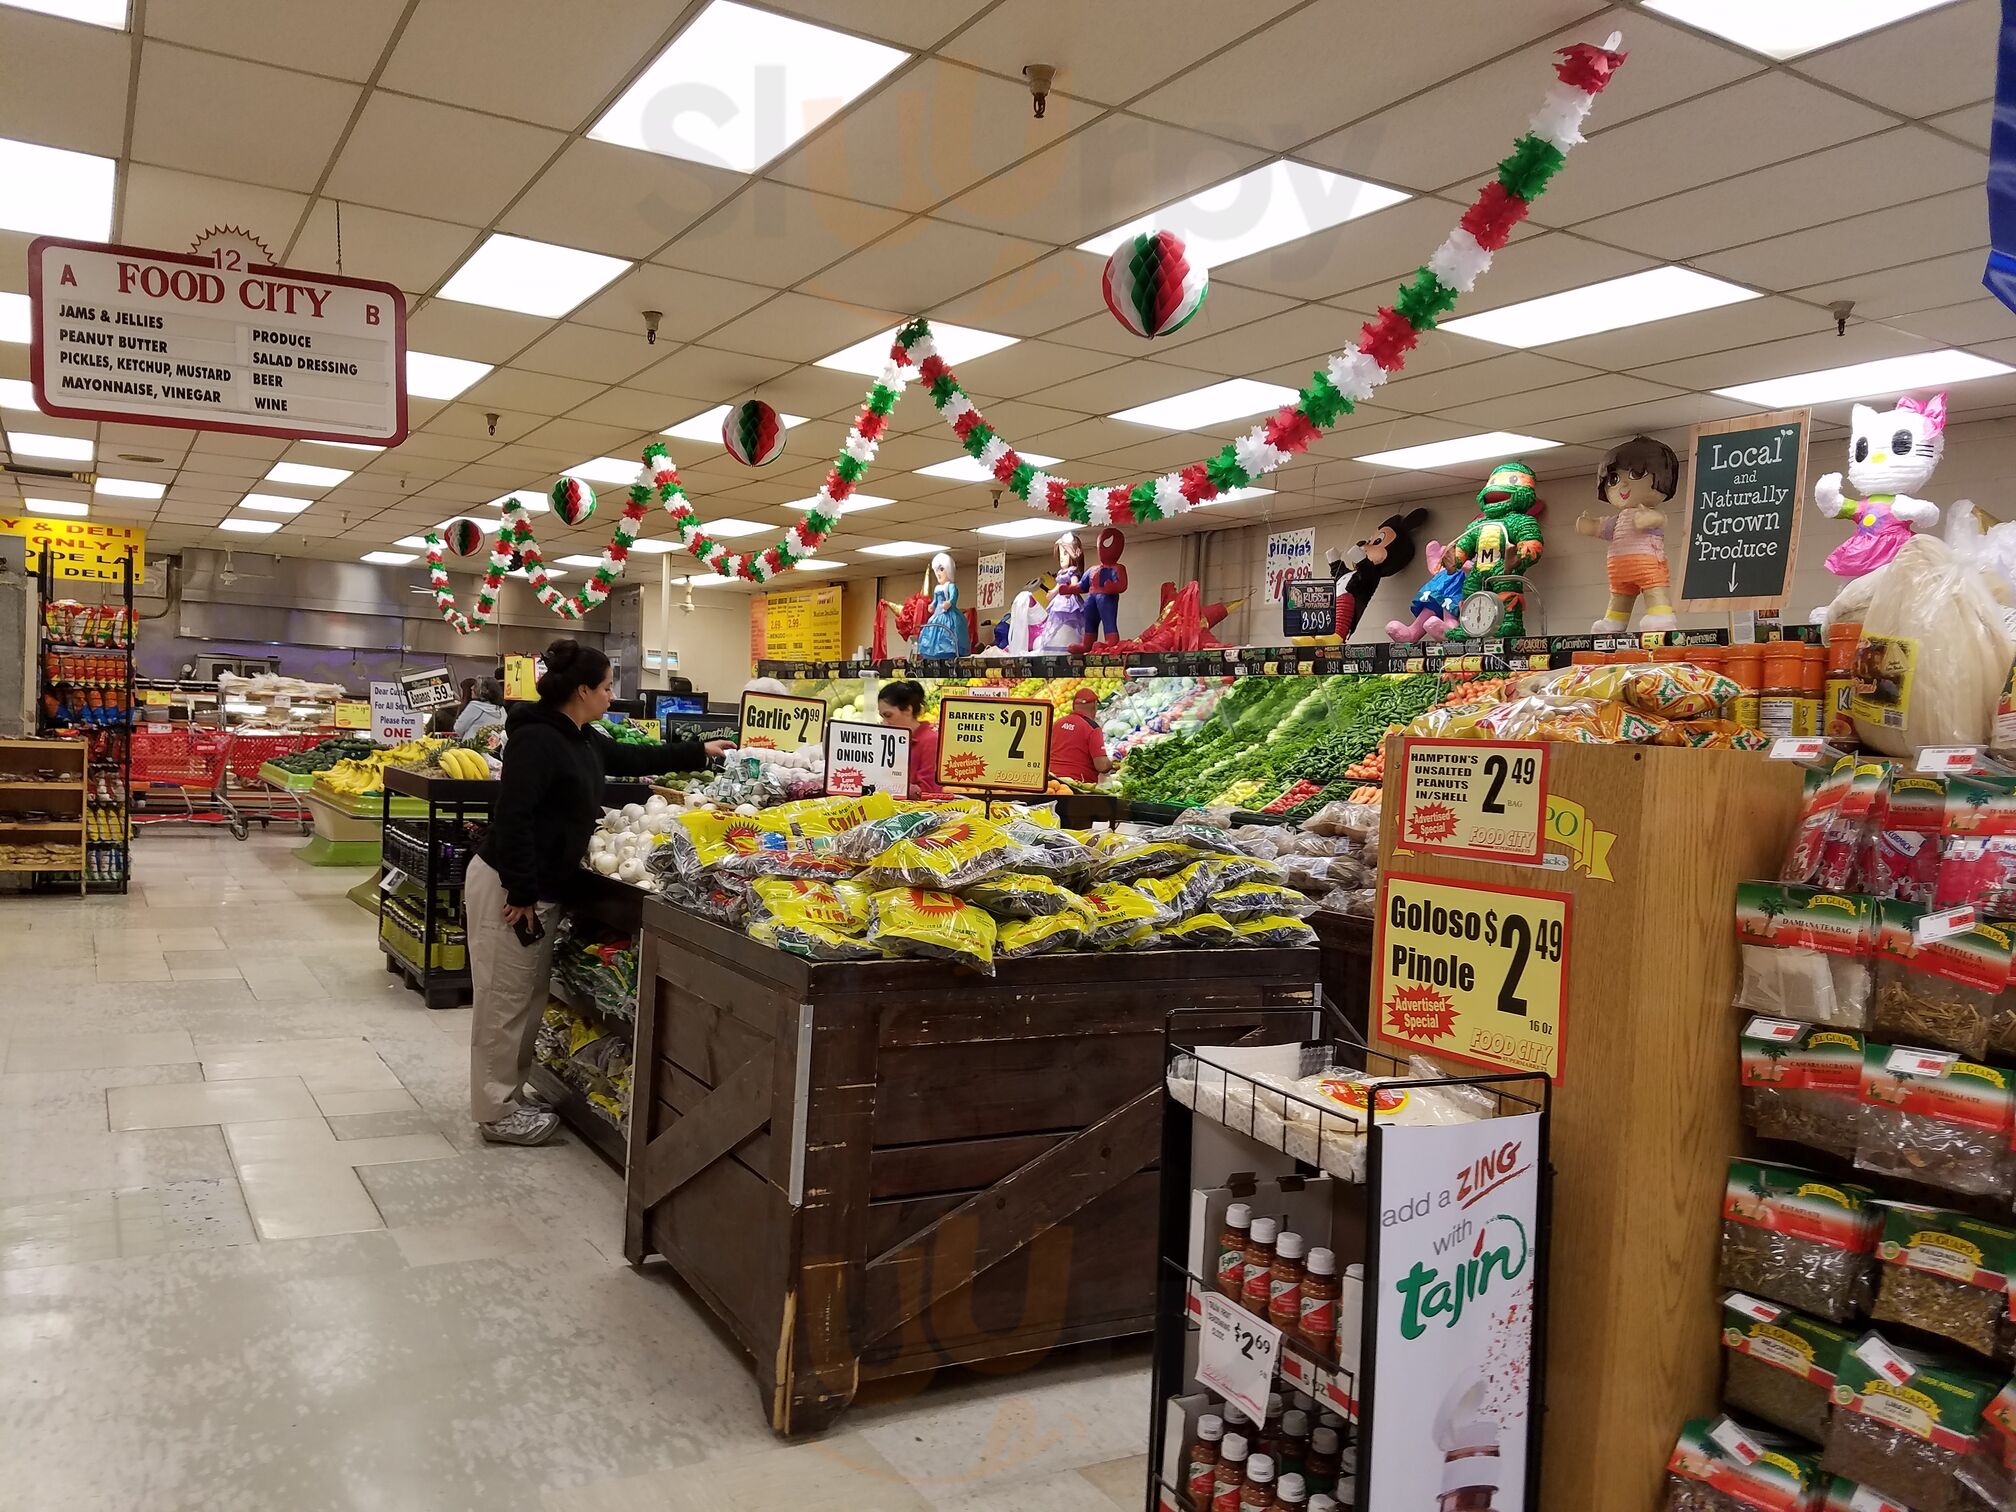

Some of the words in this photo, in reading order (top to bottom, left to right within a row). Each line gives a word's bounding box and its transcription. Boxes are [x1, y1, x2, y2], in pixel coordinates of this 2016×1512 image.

[212, 248, 242, 272] 12
[60, 264, 77, 287] A
[117, 261, 225, 304] FOOD
[239, 279, 332, 318] CITY
[59, 304, 96, 322] JAMS
[100, 309, 111, 323] &
[115, 311, 163, 329] JELLIES
[365, 304, 380, 326] B
[59, 328, 113, 347] PEANUT
[118, 335, 168, 353] BUTTER
[252, 329, 311, 349] PRODUCE
[60, 351, 113, 371] PICKLES,
[116, 356, 172, 378] KETCHUP,
[176, 364, 232, 382] MUSTARD
[252, 352, 293, 369] SALAD
[297, 357, 358, 376] DRESSING
[252, 372, 283, 388] BEER
[61, 375, 158, 399] MAYONNAISE,
[162, 385, 221, 403] VINEGAR
[254, 396, 288, 412] WINE
[1711, 437, 1782, 470] Local
[1733, 470, 1757, 485] and
[1700, 485, 1789, 510] Naturally
[33, 522, 53, 531] &
[66, 525, 131, 538] DELI
[1703, 511, 1780, 536] Grown
[32, 536, 112, 550] ONLY
[1270, 538, 1311, 558] Piñatas
[1698, 540, 1778, 561] Produce
[1481, 548, 1494, 563] M
[65, 568, 118, 579] DELI
[374, 687, 388, 695] Dear
[374, 701, 384, 710] For
[386, 702, 394, 710] All
[380, 715, 399, 724] Please
[401, 717, 416, 725] Form
[746, 705, 792, 731] Garlic
[949, 711, 995, 721] BARKER'S
[383, 727, 412, 738] ONE
[957, 722, 984, 732] CHILE
[840, 730, 872, 745] WHITE
[957, 734, 983, 743] PODS
[837, 749, 874, 763] ONIONS
[948, 758, 981, 768] Advertised
[1411, 753, 1479, 764] HAMPTON'S
[954, 766, 977, 777] Special
[995, 770, 1020, 781] FOOD
[1415, 765, 1472, 777] UNSALTED
[1416, 778, 1469, 789] PEANUTS
[1415, 791, 1468, 802] IN/SHELL
[1507, 799, 1523, 808] BAG
[1414, 811, 1450, 823] Advertised
[1420, 823, 1446, 834] Special
[1469, 826, 1505, 845] FOOD
[1505, 829, 1535, 848] CITY
[1391, 893, 1481, 941] Goloso
[1782, 918, 1819, 931] DAMIANA
[1821, 922, 1834, 932] TEA
[1836, 924, 1852, 935] BAG
[1392, 944, 1475, 992] Pinole
[1395, 997, 1445, 1012] Advertised
[1404, 1013, 1439, 1030] Special
[1529, 1019, 1540, 1032] 16
[1470, 1028, 1516, 1055] FOOD
[1518, 1039, 1553, 1066] CITY
[1382, 1192, 1430, 1227] add
[1438, 1190, 1451, 1208] a
[1456, 1141, 1522, 1201] ZING
[1433, 1218, 1472, 1255] with
